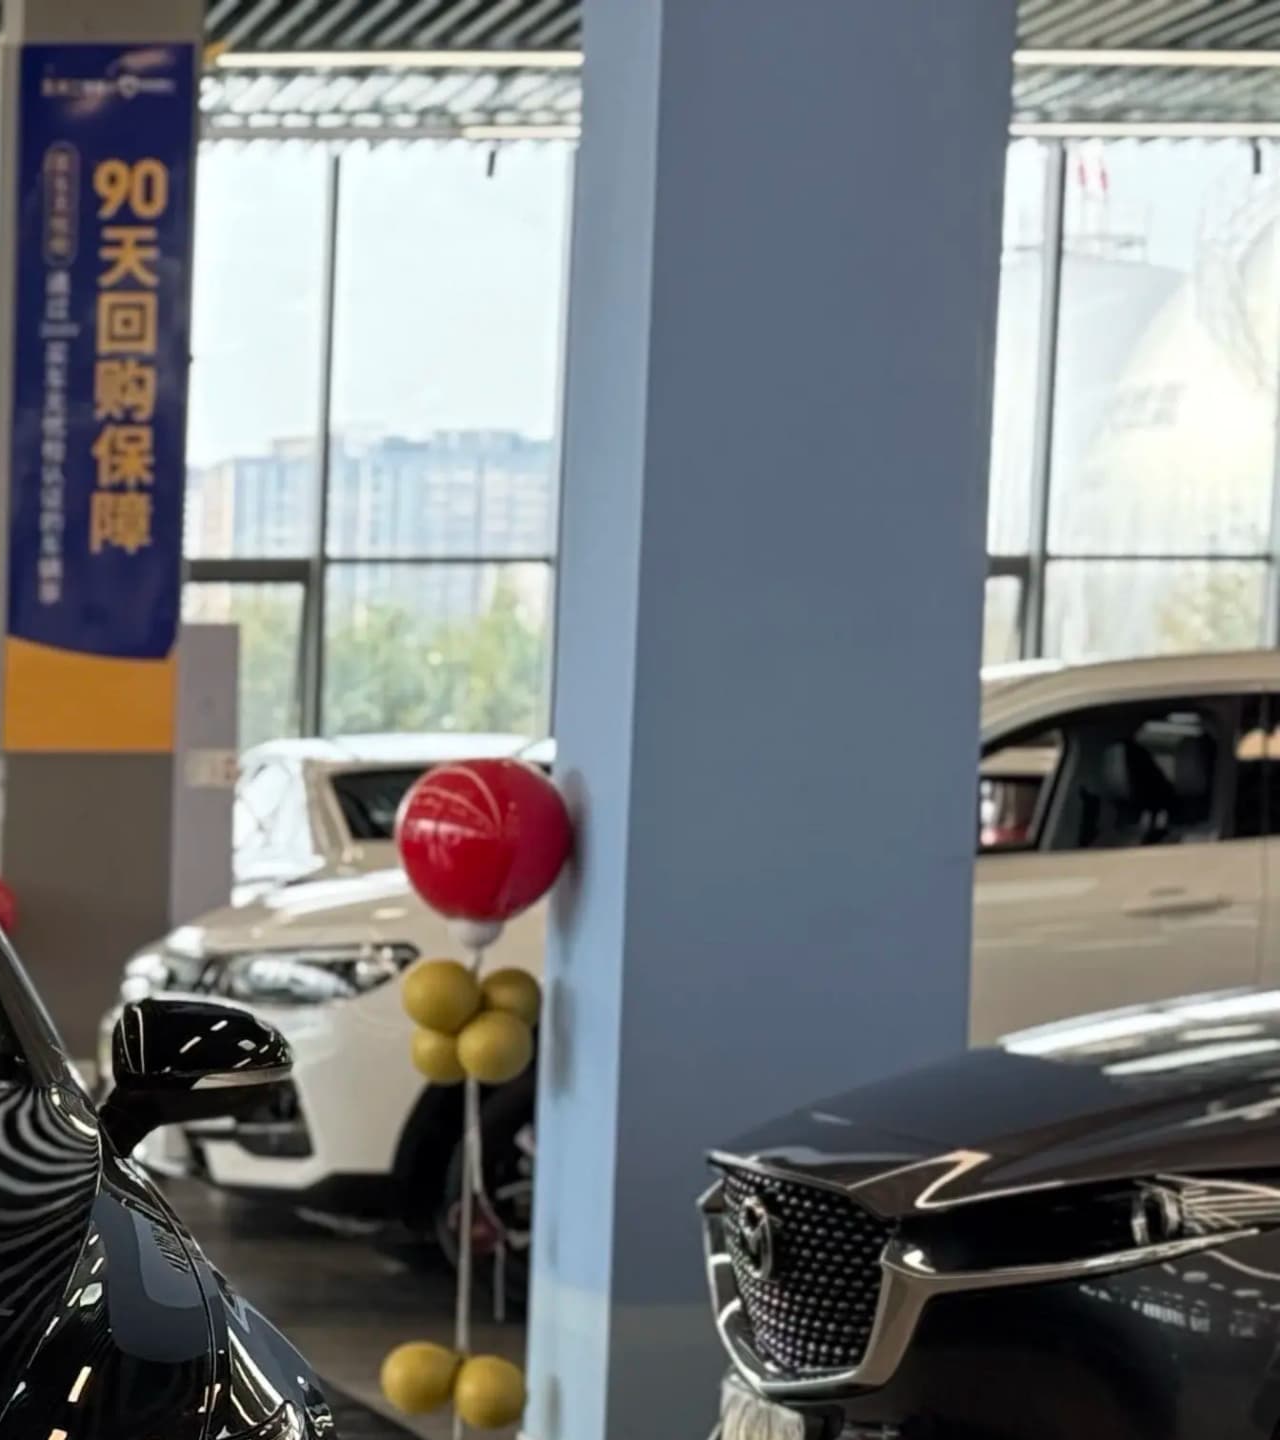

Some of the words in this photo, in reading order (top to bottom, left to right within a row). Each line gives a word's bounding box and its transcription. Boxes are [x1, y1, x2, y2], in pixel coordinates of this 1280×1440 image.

[89, 157, 169, 555] 90天回购保障
